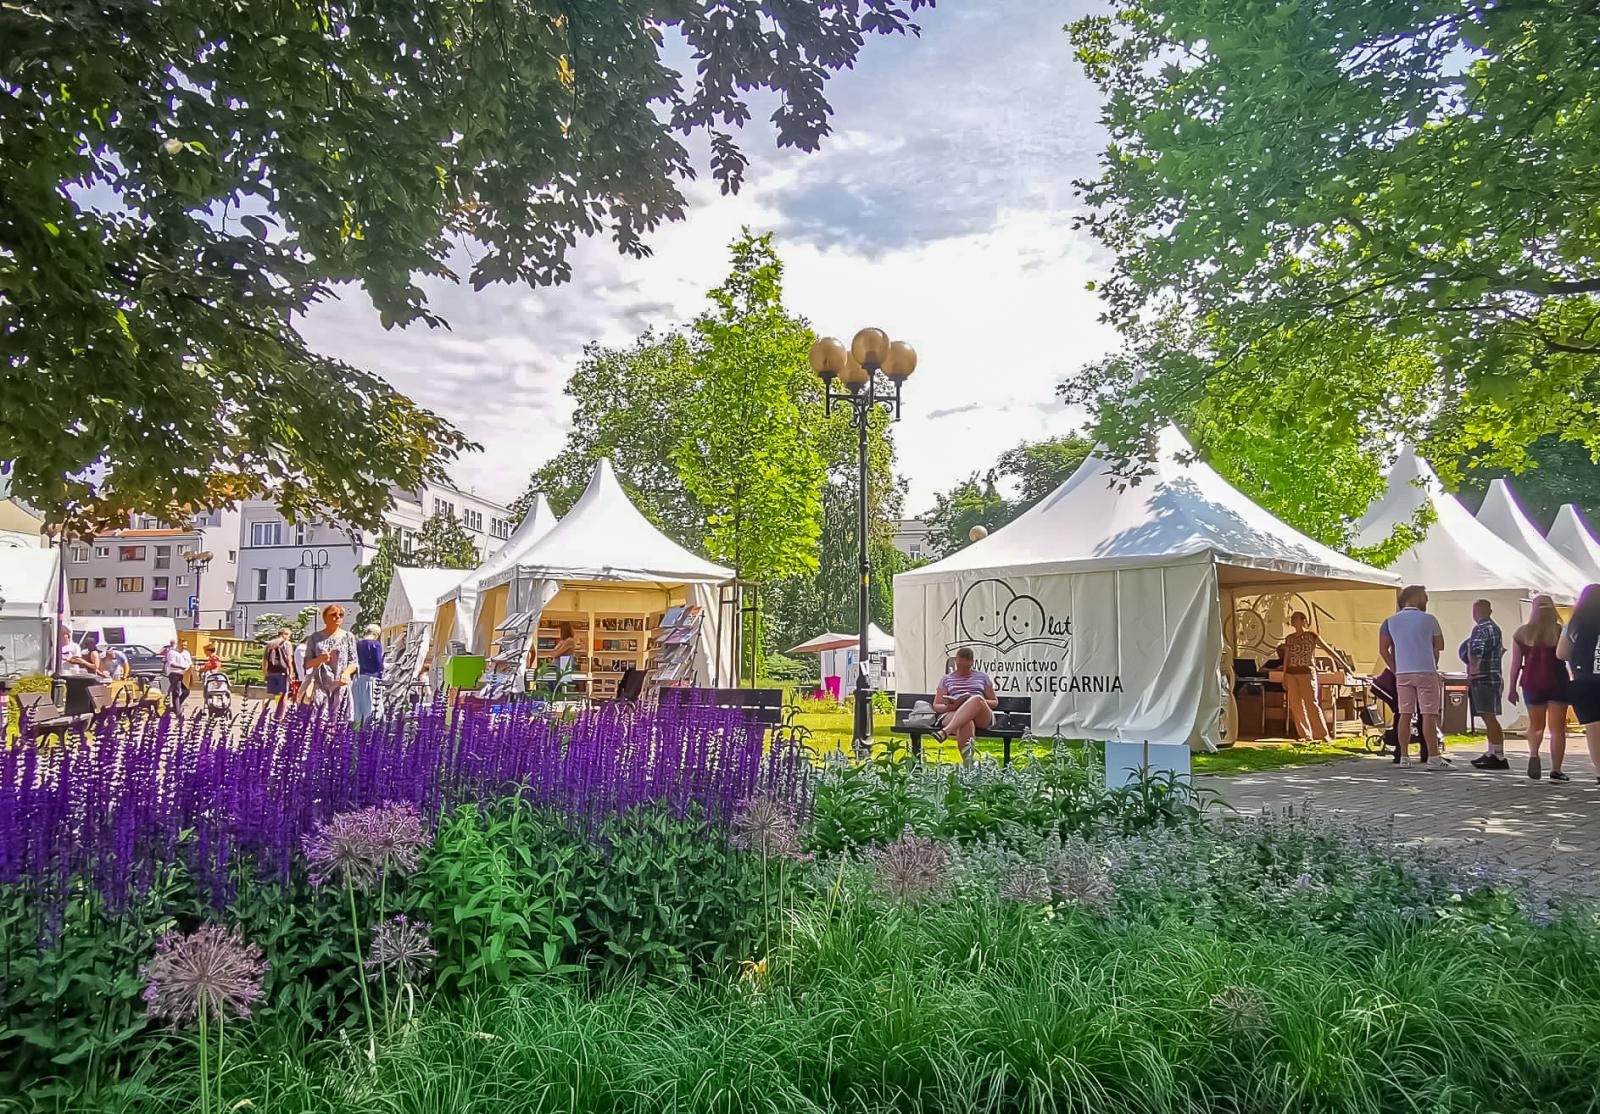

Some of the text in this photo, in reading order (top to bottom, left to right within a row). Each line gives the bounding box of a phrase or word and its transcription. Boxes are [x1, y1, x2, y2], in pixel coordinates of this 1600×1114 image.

[1047, 615, 1072, 636] lat
[971, 658, 1058, 673] Wydawnictwo
[994, 675, 1124, 697] SZA KSIĘGARNIA
